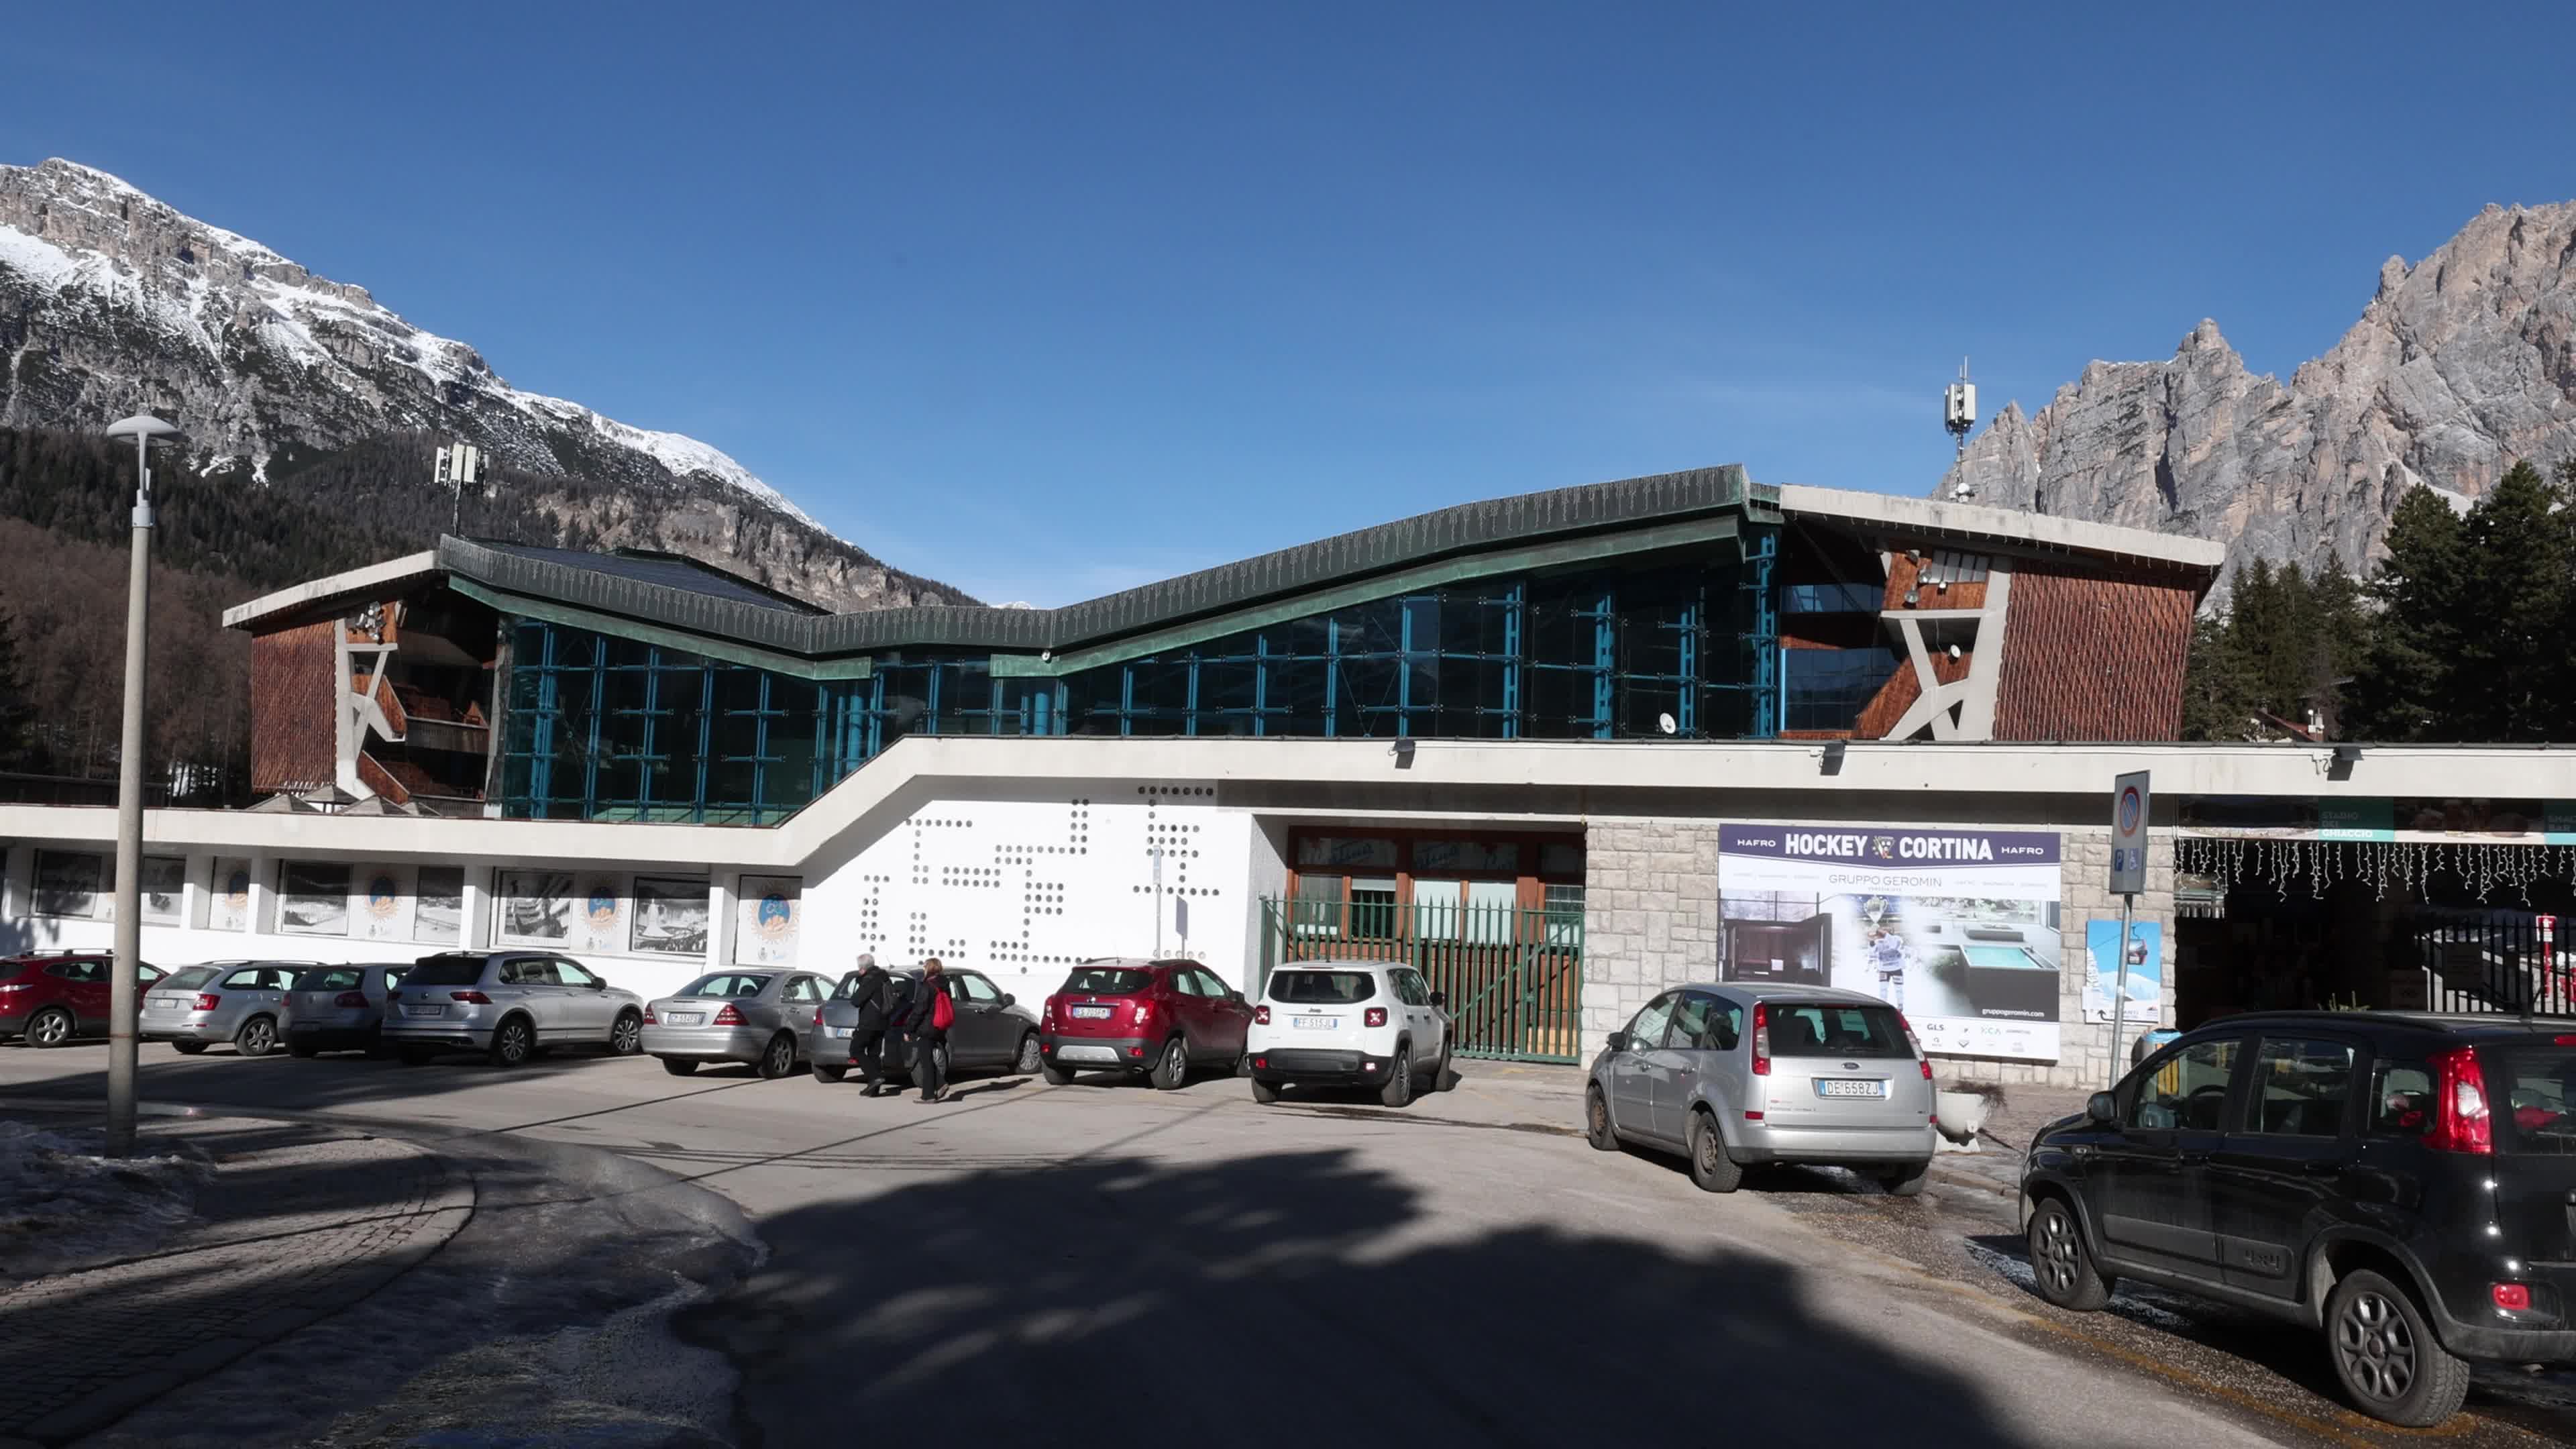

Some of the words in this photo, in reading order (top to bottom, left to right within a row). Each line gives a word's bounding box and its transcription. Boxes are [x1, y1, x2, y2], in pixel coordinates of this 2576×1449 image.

[2322, 811, 2359, 820] STADIO
[2322, 828, 2373, 838] GHIACCIO
[1737, 839, 1776, 847] HAFRO
[1785, 834, 1868, 857] HOCKEY
[1899, 837, 1994, 860] CORTINA
[2001, 847, 2045, 855] HAFRO
[1828, 874, 1879, 885] GRUPPO
[1882, 875, 1942, 888] GEROMIN
[1827, 1082, 1841, 1094] DE
[1844, 1082, 1879, 1095] 658ZJ
